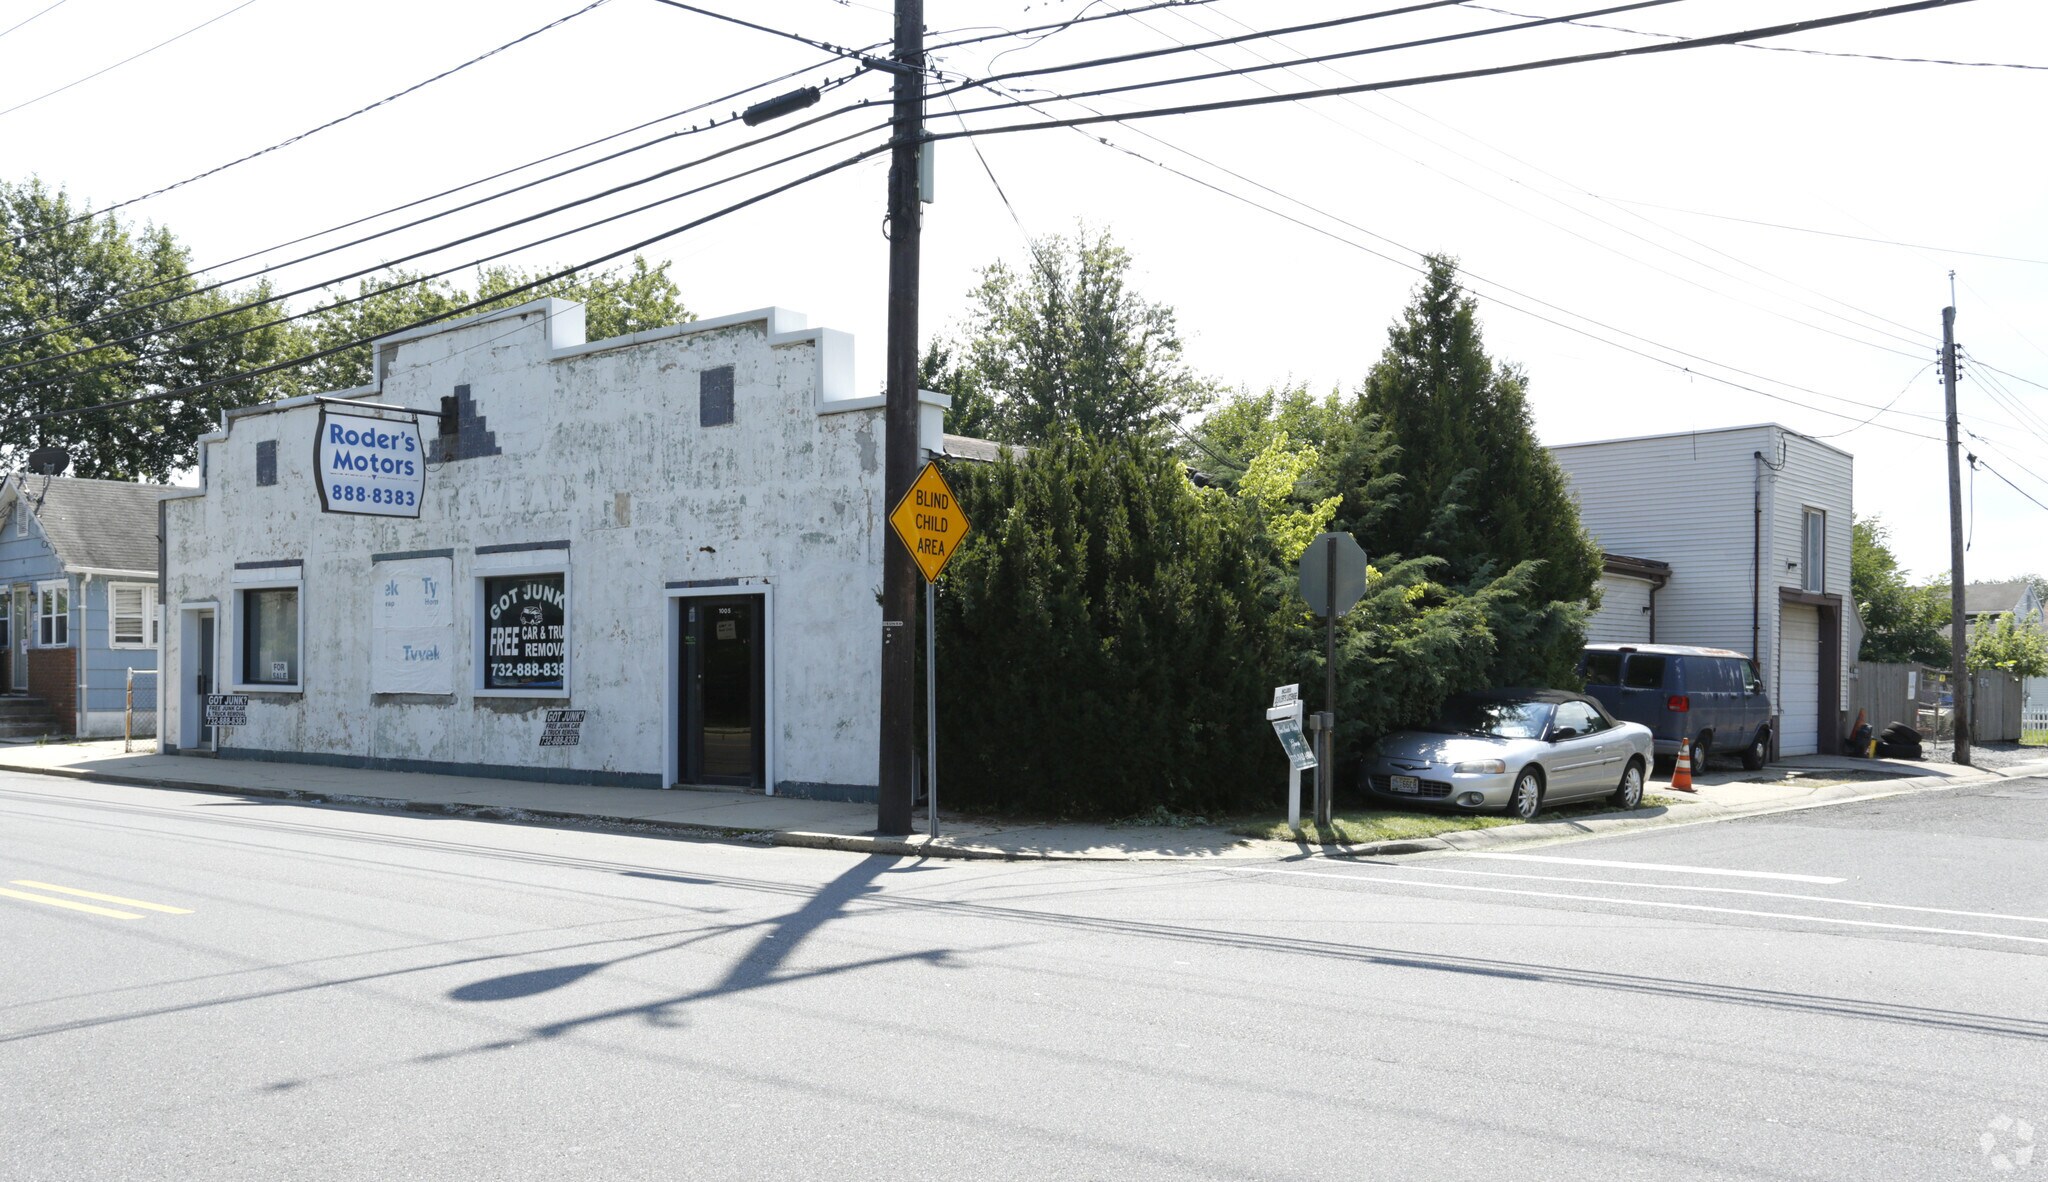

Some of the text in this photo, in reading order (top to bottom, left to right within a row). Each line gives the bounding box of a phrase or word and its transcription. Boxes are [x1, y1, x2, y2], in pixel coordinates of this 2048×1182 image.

[330, 423, 415, 452] Roder's
[332, 449, 414, 476] Motors
[916, 489, 949, 510] BLIND
[916, 513, 948, 533] CHILD
[917, 537, 945, 556] AREA
[490, 583, 564, 620] GOT JUNK
[489, 626, 519, 656] FREE
[521, 626, 538, 640] CAR
[540, 625, 546, 639] &
[273, 663, 285, 671] FOR
[209, 696, 247, 705] GOT JUNK?
[547, 711, 584, 722] GOT JUNK?
